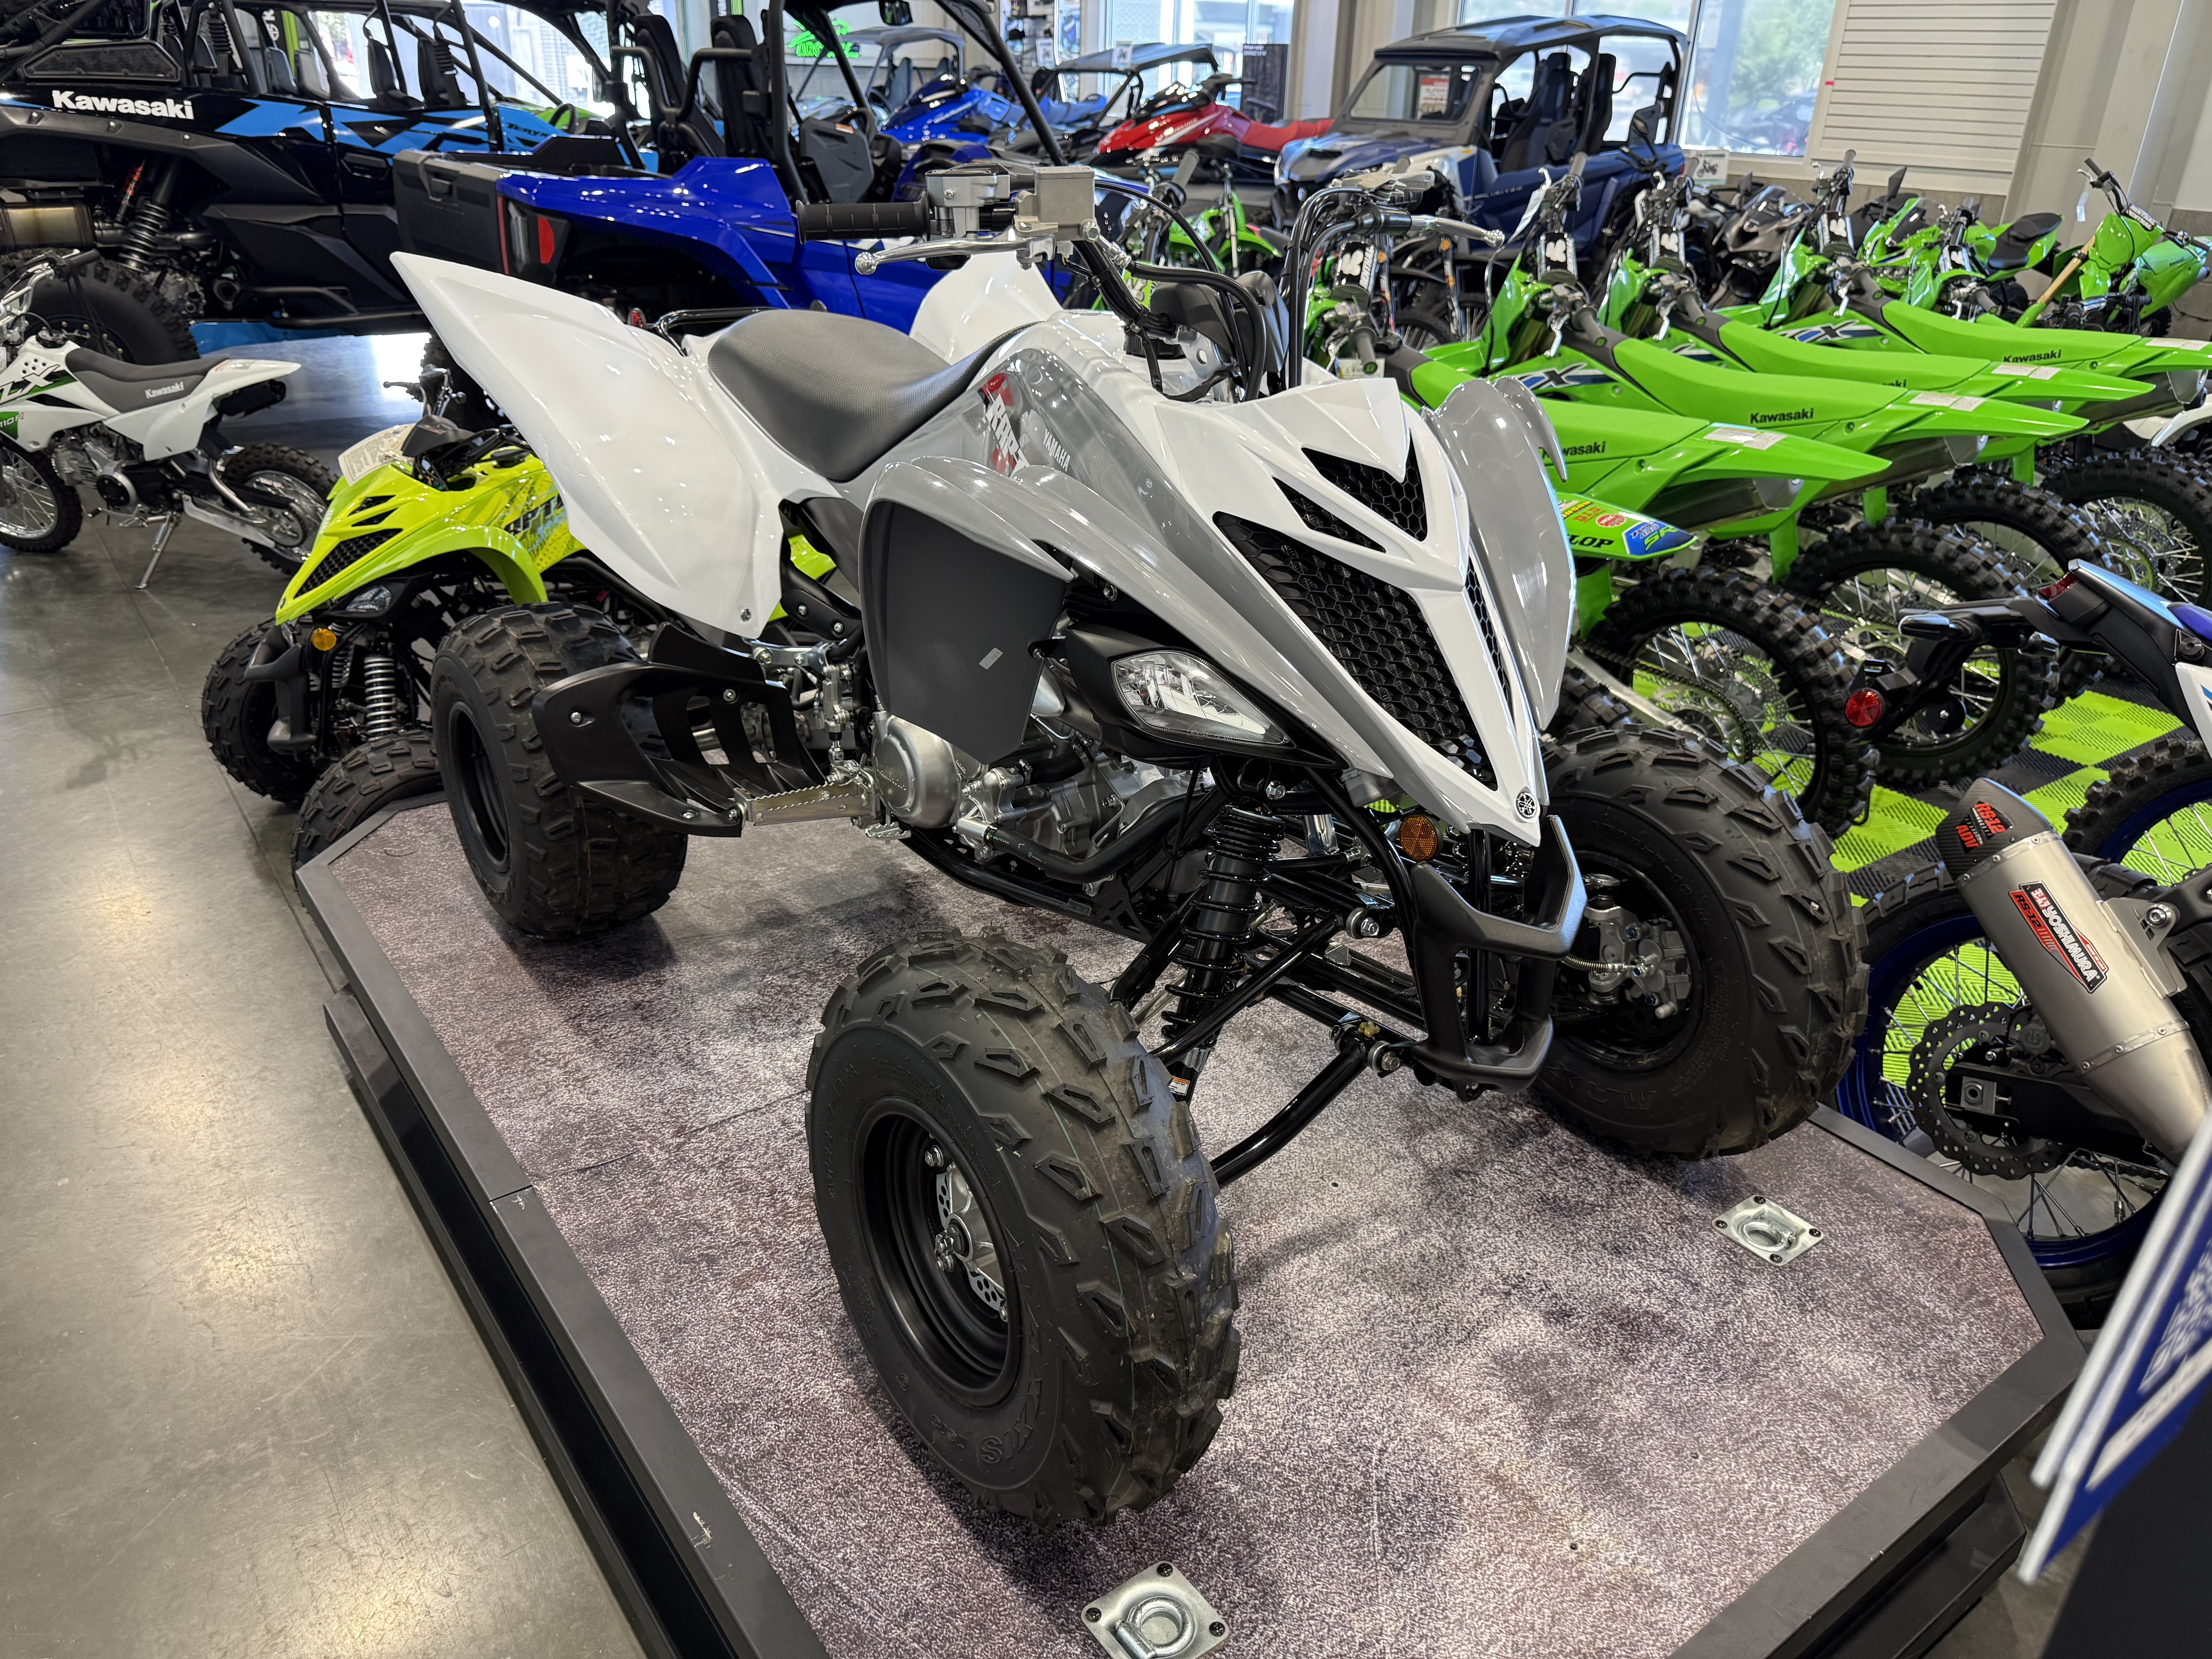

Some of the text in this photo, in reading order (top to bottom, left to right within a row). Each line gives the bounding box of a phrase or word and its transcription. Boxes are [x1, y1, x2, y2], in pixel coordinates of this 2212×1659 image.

[52, 90, 194, 120] Kawasaki
[2003, 349, 2062, 363] Kawasaki
[145, 382, 184, 399] Kawasaki
[1750, 408, 1814, 424] Kawasaki
[1043, 428, 1071, 472] YAMAHA
[1538, 441, 1606, 460] Kwasaki
[1974, 803, 2007, 834] RS-12
[1956, 825, 1980, 848] ADV
[2014, 894, 2042, 928] RS-12
[2042, 905, 2098, 982] YOSHIMURA
